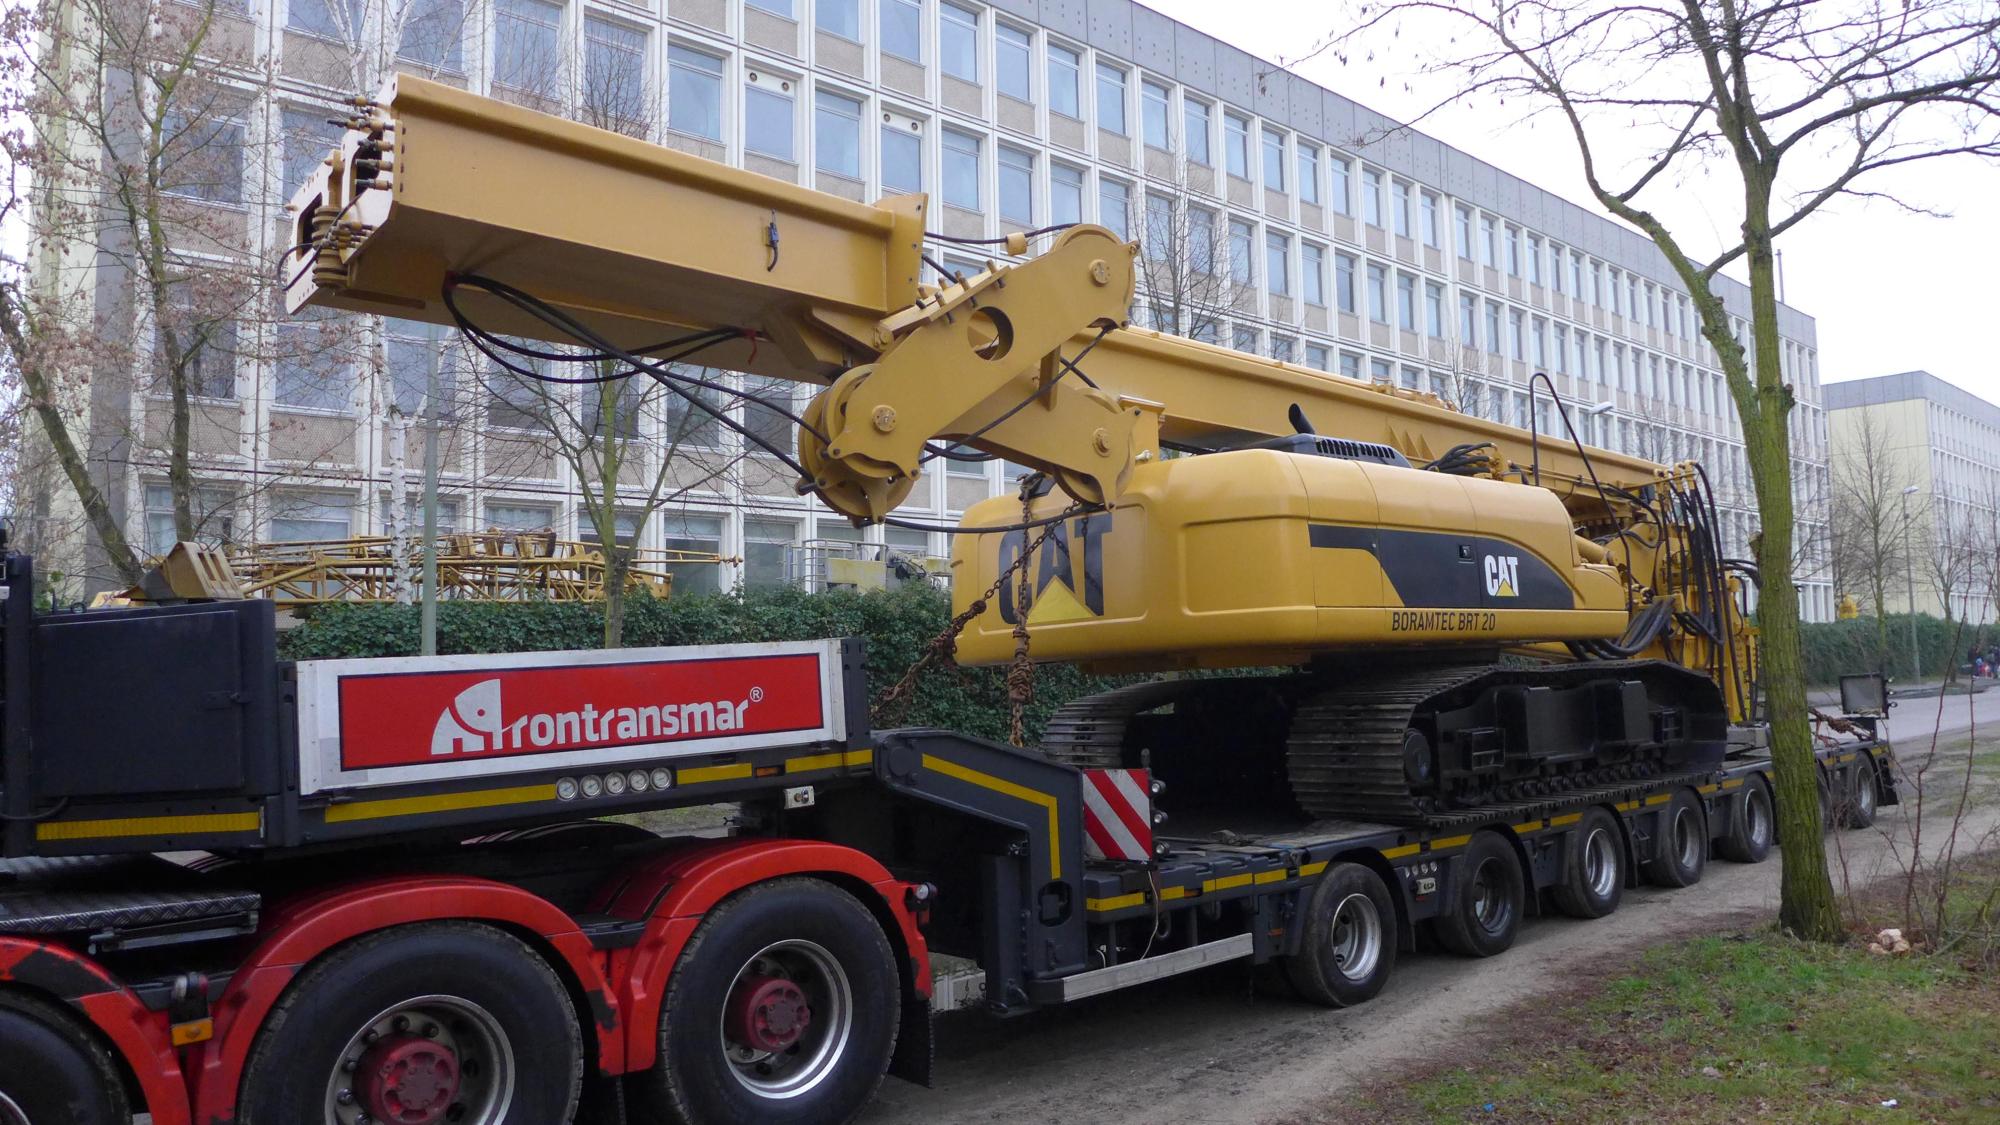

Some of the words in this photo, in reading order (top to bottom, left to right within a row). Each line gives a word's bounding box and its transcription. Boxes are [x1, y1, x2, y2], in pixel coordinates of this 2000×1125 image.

[998, 512, 1112, 625] CAT
[1484, 554, 1520, 597] CAT
[1392, 611, 1456, 632] BORAMTEC
[1457, 612, 1480, 632] BRT
[1481, 612, 1496, 632] 20
